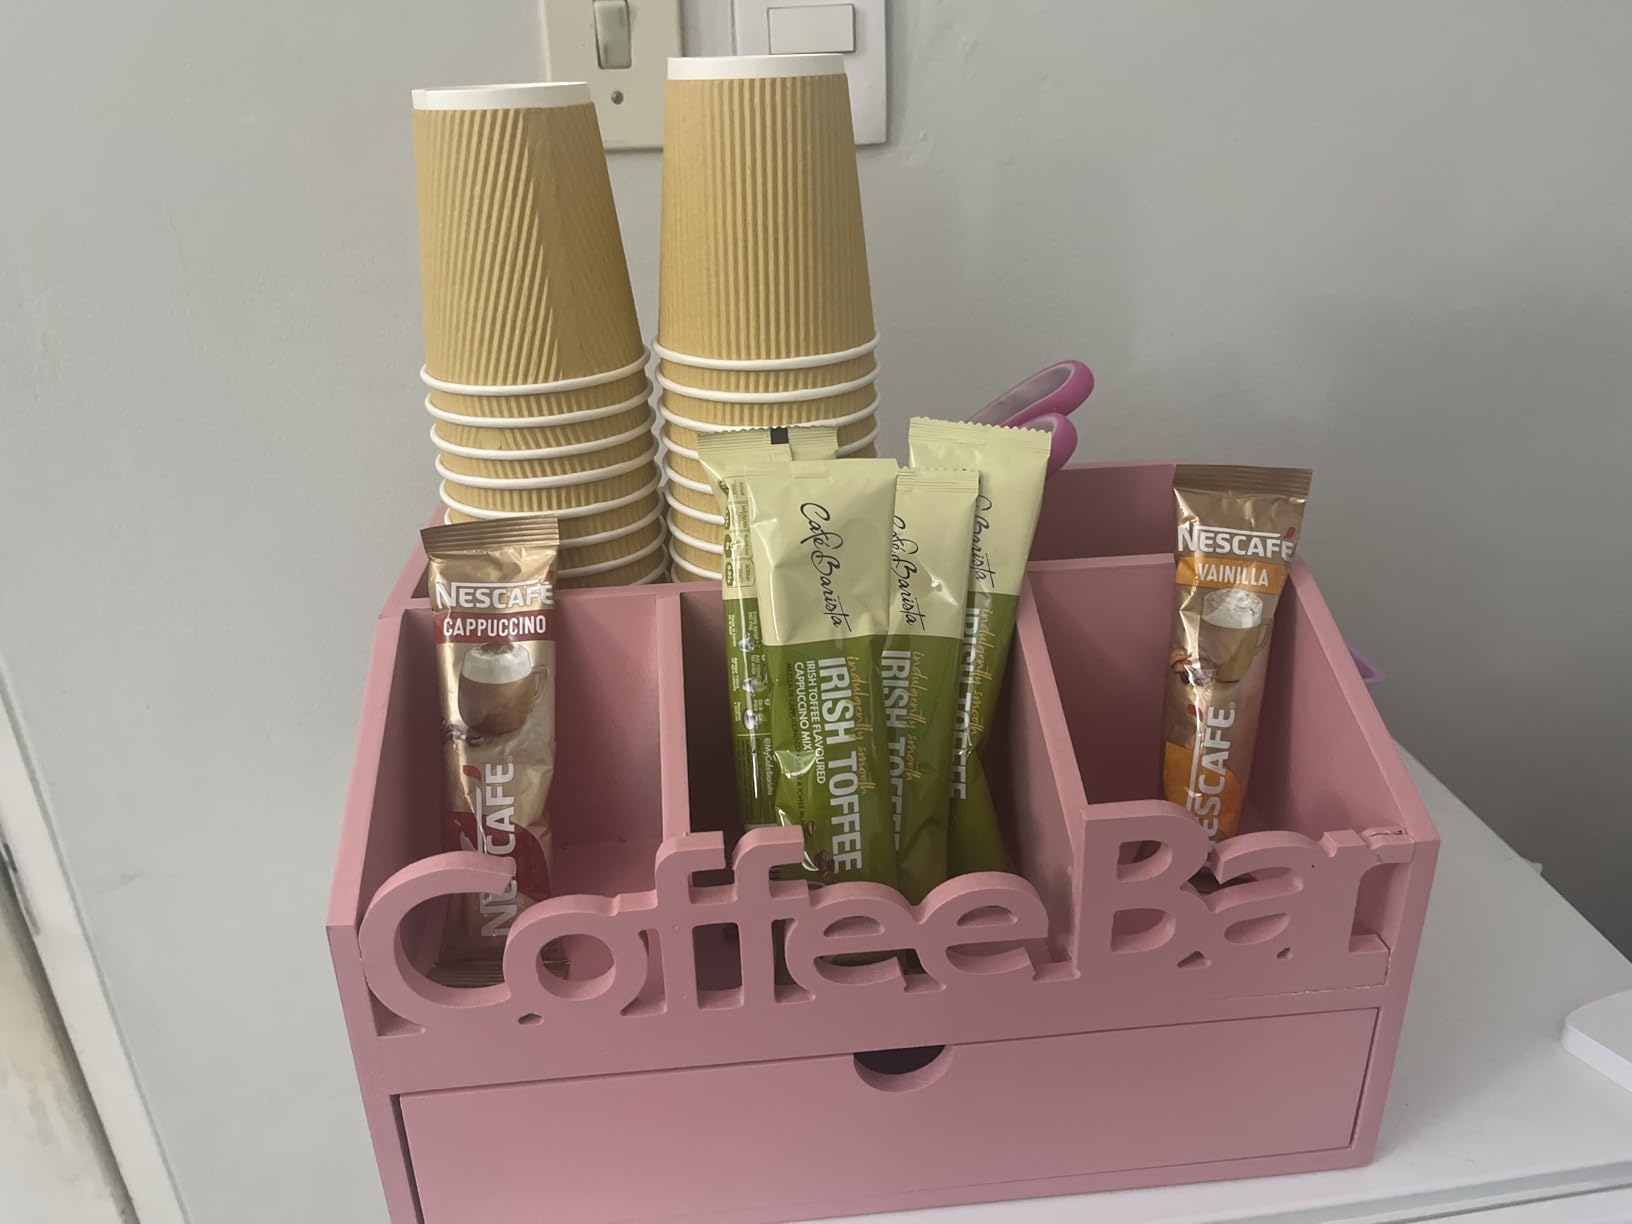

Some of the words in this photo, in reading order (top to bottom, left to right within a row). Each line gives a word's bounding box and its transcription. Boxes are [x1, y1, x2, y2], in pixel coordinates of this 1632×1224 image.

[800, 502, 844, 551] Café
[1177, 525, 1298, 562] NESCAFÉ
[811, 550, 852, 632] Barista
[890, 554, 926, 631] Barista
[1199, 562, 1269, 587] VAINILLA
[443, 614, 547, 637] CAPPUCCINO
[972, 608, 997, 685] indulgently
[794, 662, 810, 730] CAPPUCCINO
[806, 660, 818, 686] IRISH
[818, 657, 858, 745] IRISH
[845, 656, 873, 740] indulgently
[881, 650, 911, 728] IRISH
[905, 650, 928, 729] indulgently
[808, 686, 821, 723] TOFFEE
[970, 688, 985, 735] smooth
[800, 731, 813, 750] MIX
[811, 724, 827, 784] FLAVOURED
[855, 746, 877, 795] smooth
[904, 734, 922, 782] smooth
[828, 750, 863, 874] TOFFEE
[357, 825, 1052, 1028] Coffee
[1066, 799, 1415, 980] Bar
